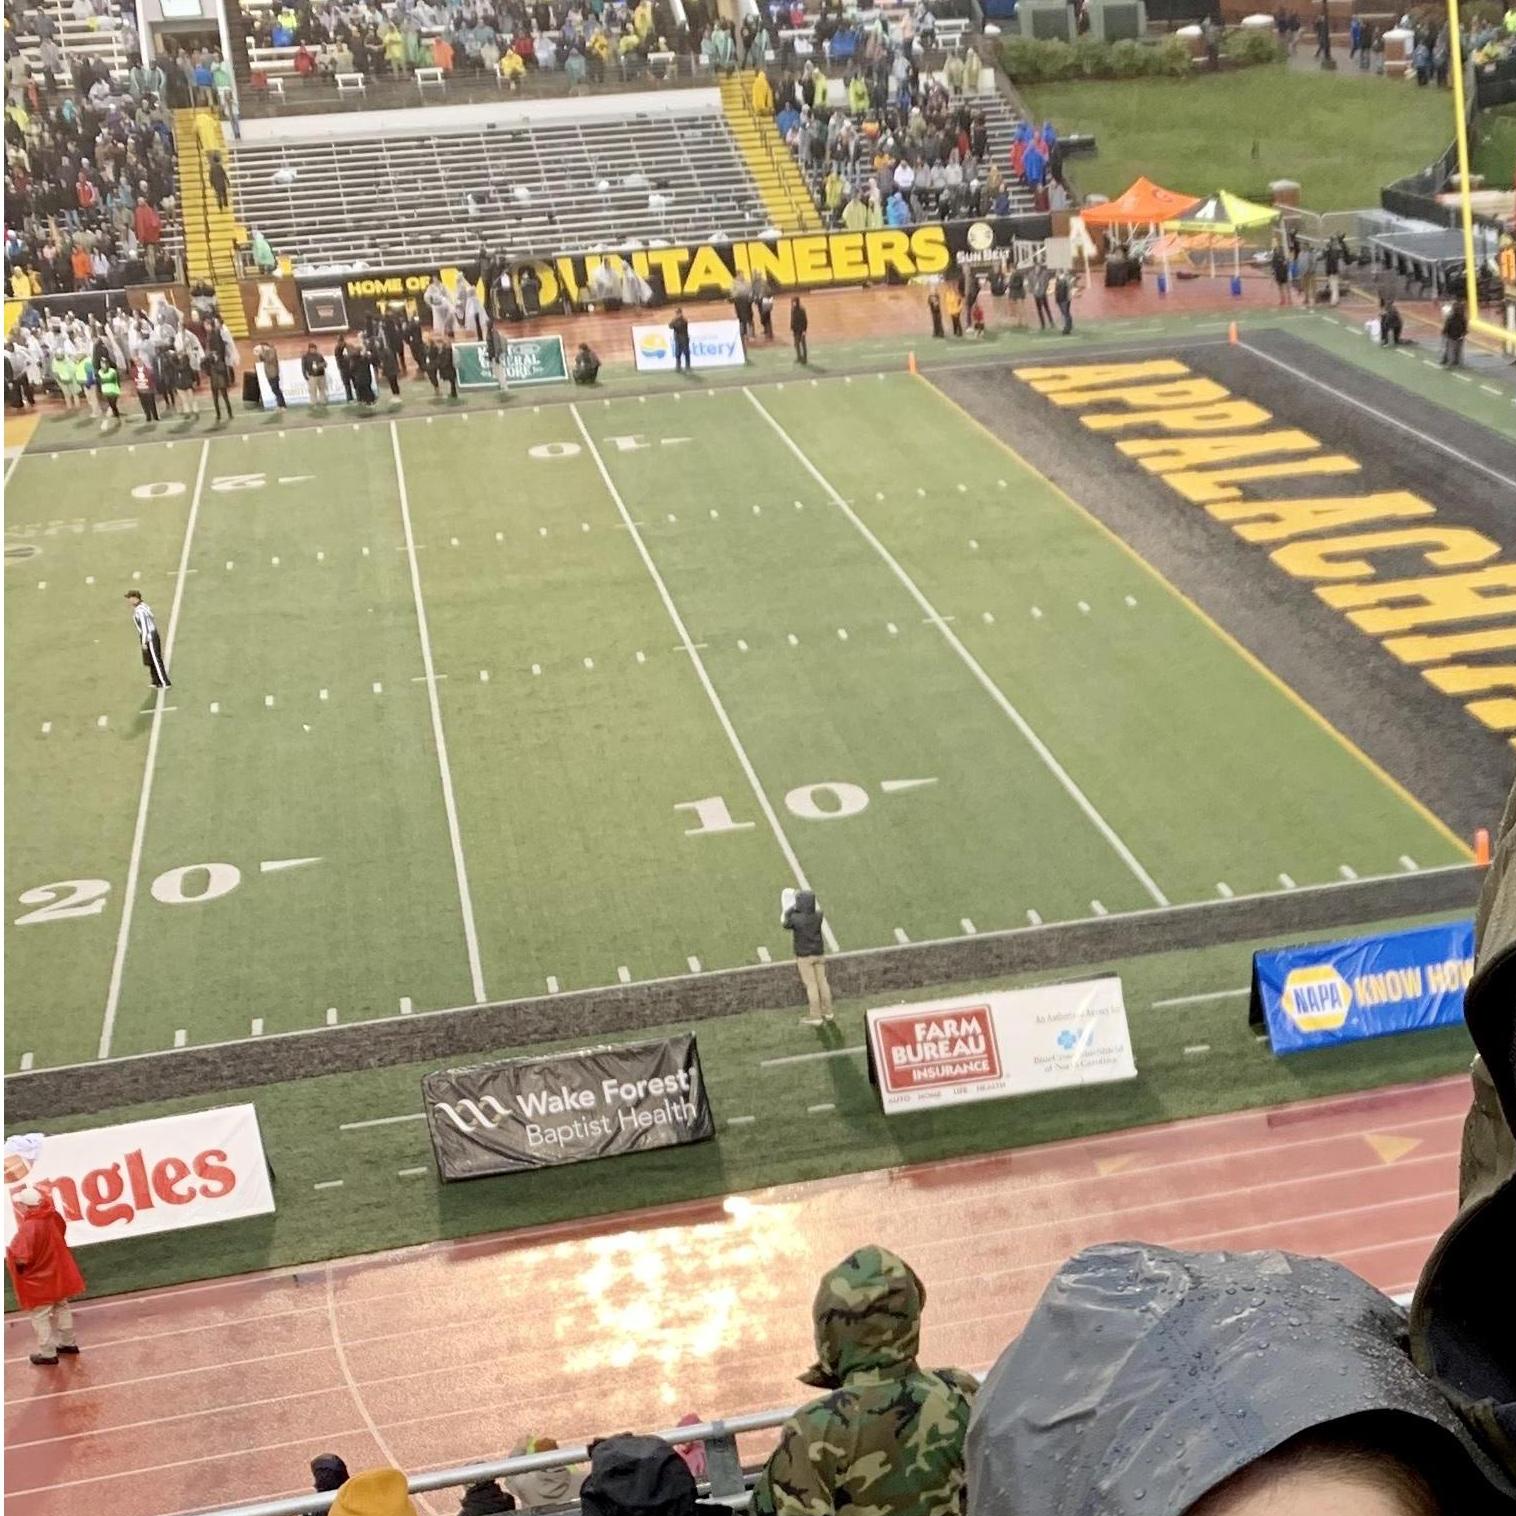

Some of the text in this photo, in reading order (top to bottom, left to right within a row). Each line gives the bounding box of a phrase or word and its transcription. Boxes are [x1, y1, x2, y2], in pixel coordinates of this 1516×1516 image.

[254, 281, 295, 329] A
[348, 276, 431, 297] HOME OF
[673, 782, 870, 836] 10
[14, 861, 242, 926] 20
[1291, 981, 1343, 1014] NAPA
[1354, 966, 1422, 1008] KNOW
[913, 1014, 983, 1042] FARM
[890, 1034, 987, 1066] BUREAU
[911, 1058, 991, 1082] INSURANCE
[516, 1068, 692, 1119] Wake Forest
[525, 1096, 698, 1149] Baptist Health
